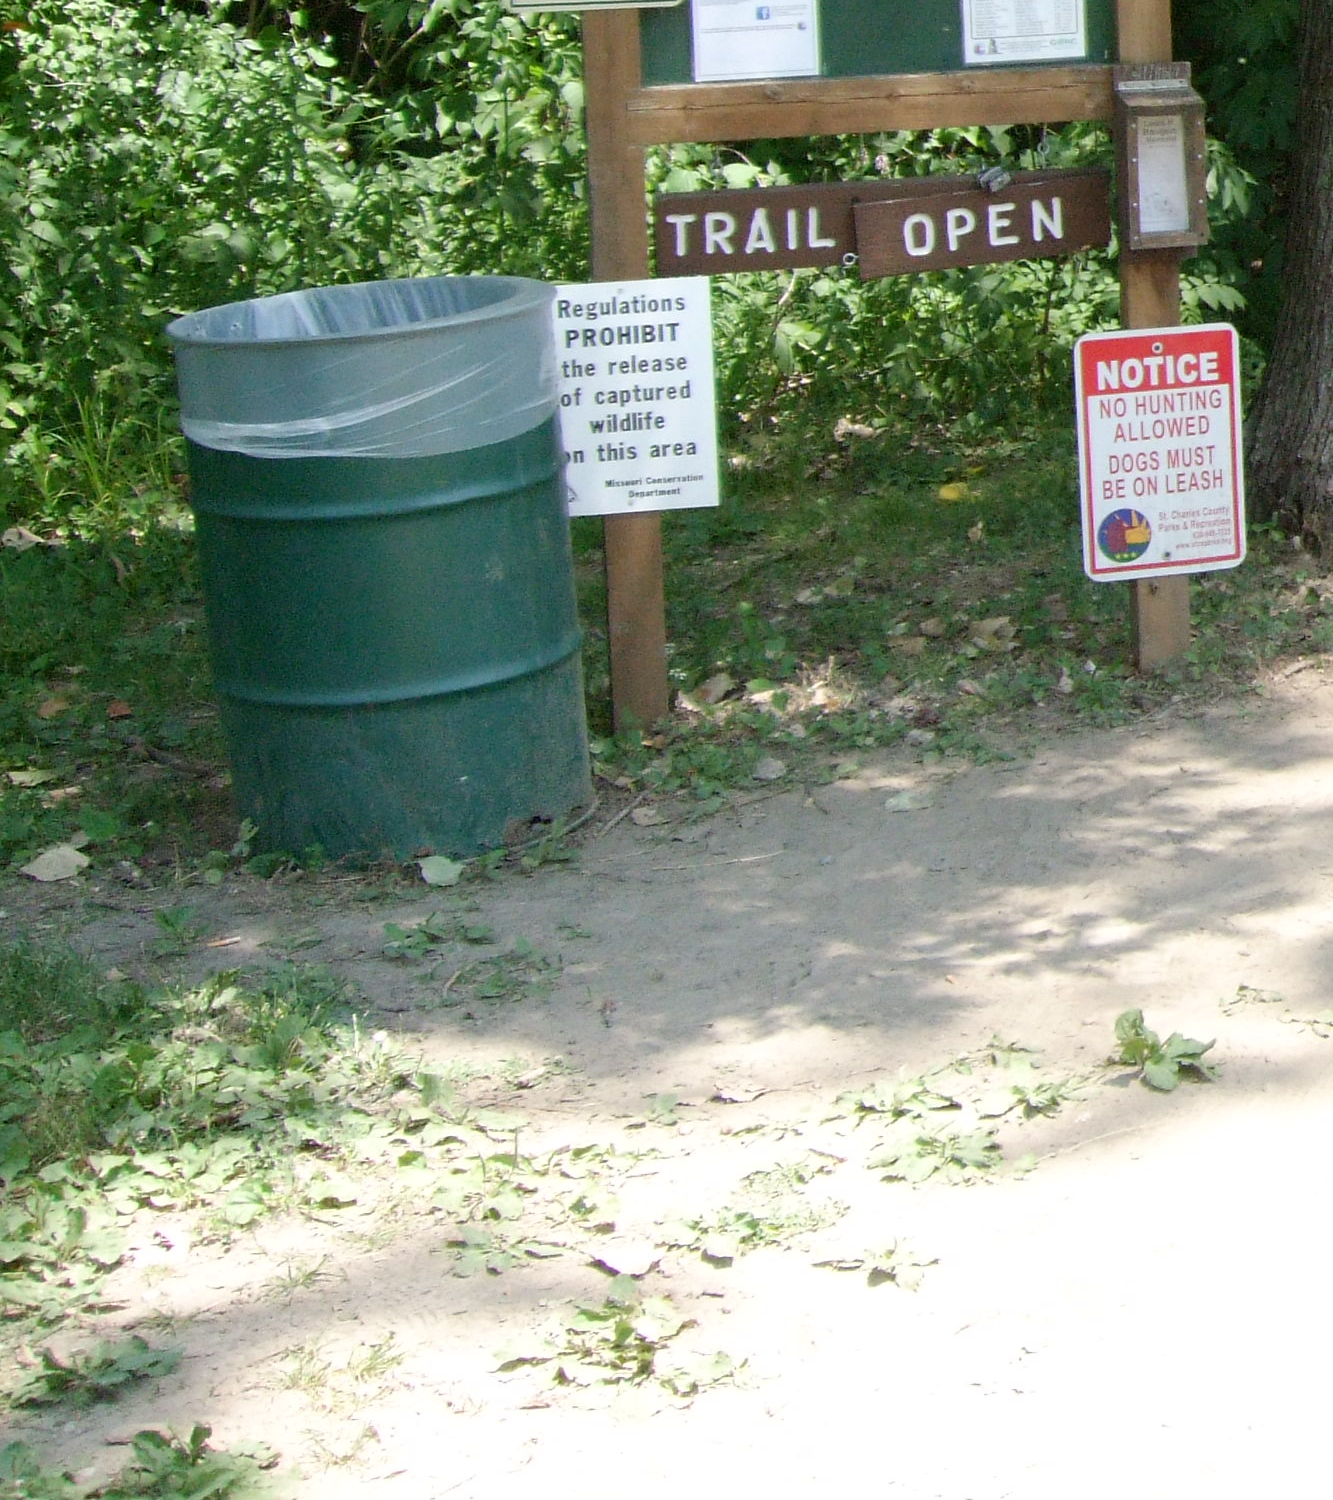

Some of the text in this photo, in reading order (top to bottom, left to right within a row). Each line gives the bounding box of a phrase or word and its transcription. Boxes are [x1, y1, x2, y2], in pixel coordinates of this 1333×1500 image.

[666, 198, 1062, 256] TRAIL OPEN
[558, 295, 685, 320] Regulations
[566, 323, 679, 348] PROHIBIT
[562, 356, 687, 378] the release
[1097, 352, 1219, 391] NOTICE
[561, 380, 690, 407] of captured
[1100, 389, 1222, 419] NO HUNTING
[590, 412, 664, 433] wildlife
[1114, 416, 1210, 443] ALLOWED
[597, 443, 637, 461] this
[651, 443, 696, 457] area
[1109, 446, 1215, 474] DOGS MUST
[605, 475, 703, 488] Missouri Conservation
[629, 488, 680, 498] Department
[1103, 470, 1223, 500] BE ON LEASH
[1158, 522, 1180, 532] Parks
[1191, 517, 1231, 529] Recreation
[1172, 509, 1200, 520] Charles
[1203, 506, 1229, 518] County
